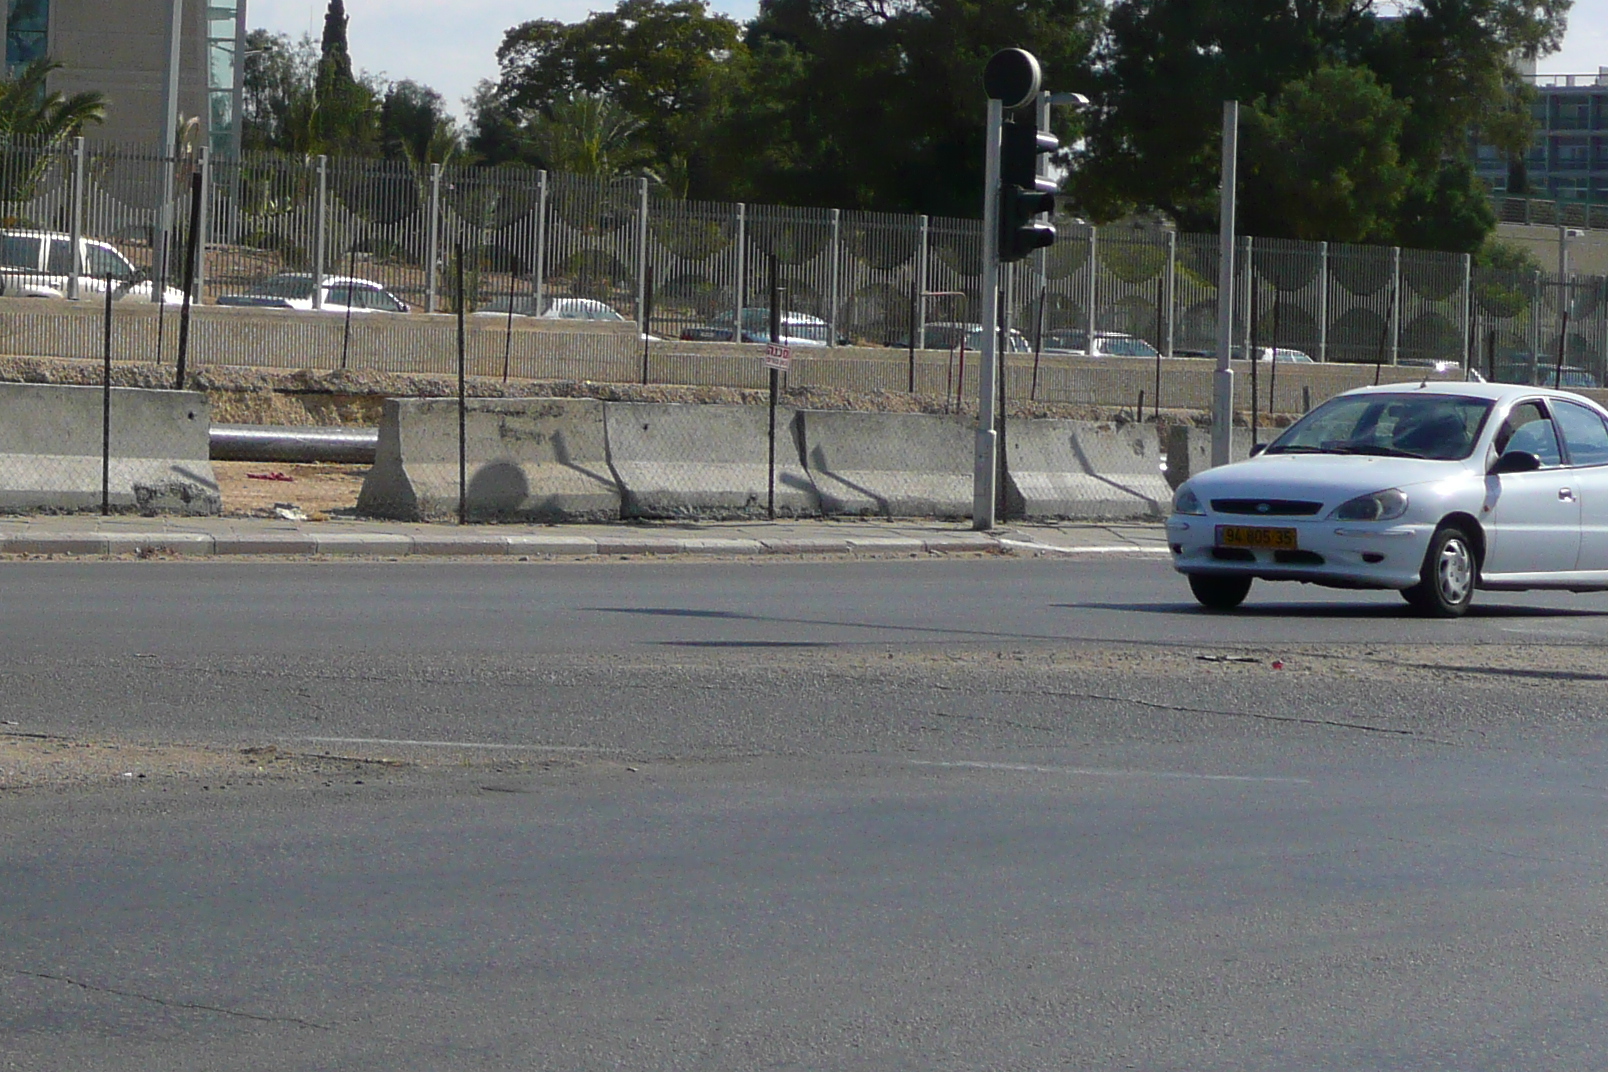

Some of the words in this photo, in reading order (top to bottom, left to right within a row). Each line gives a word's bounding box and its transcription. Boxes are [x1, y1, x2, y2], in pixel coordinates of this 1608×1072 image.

[766, 345, 790, 359] סכנה
[1226, 528, 1243, 542] 94
[1275, 530, 1292, 544] 35
